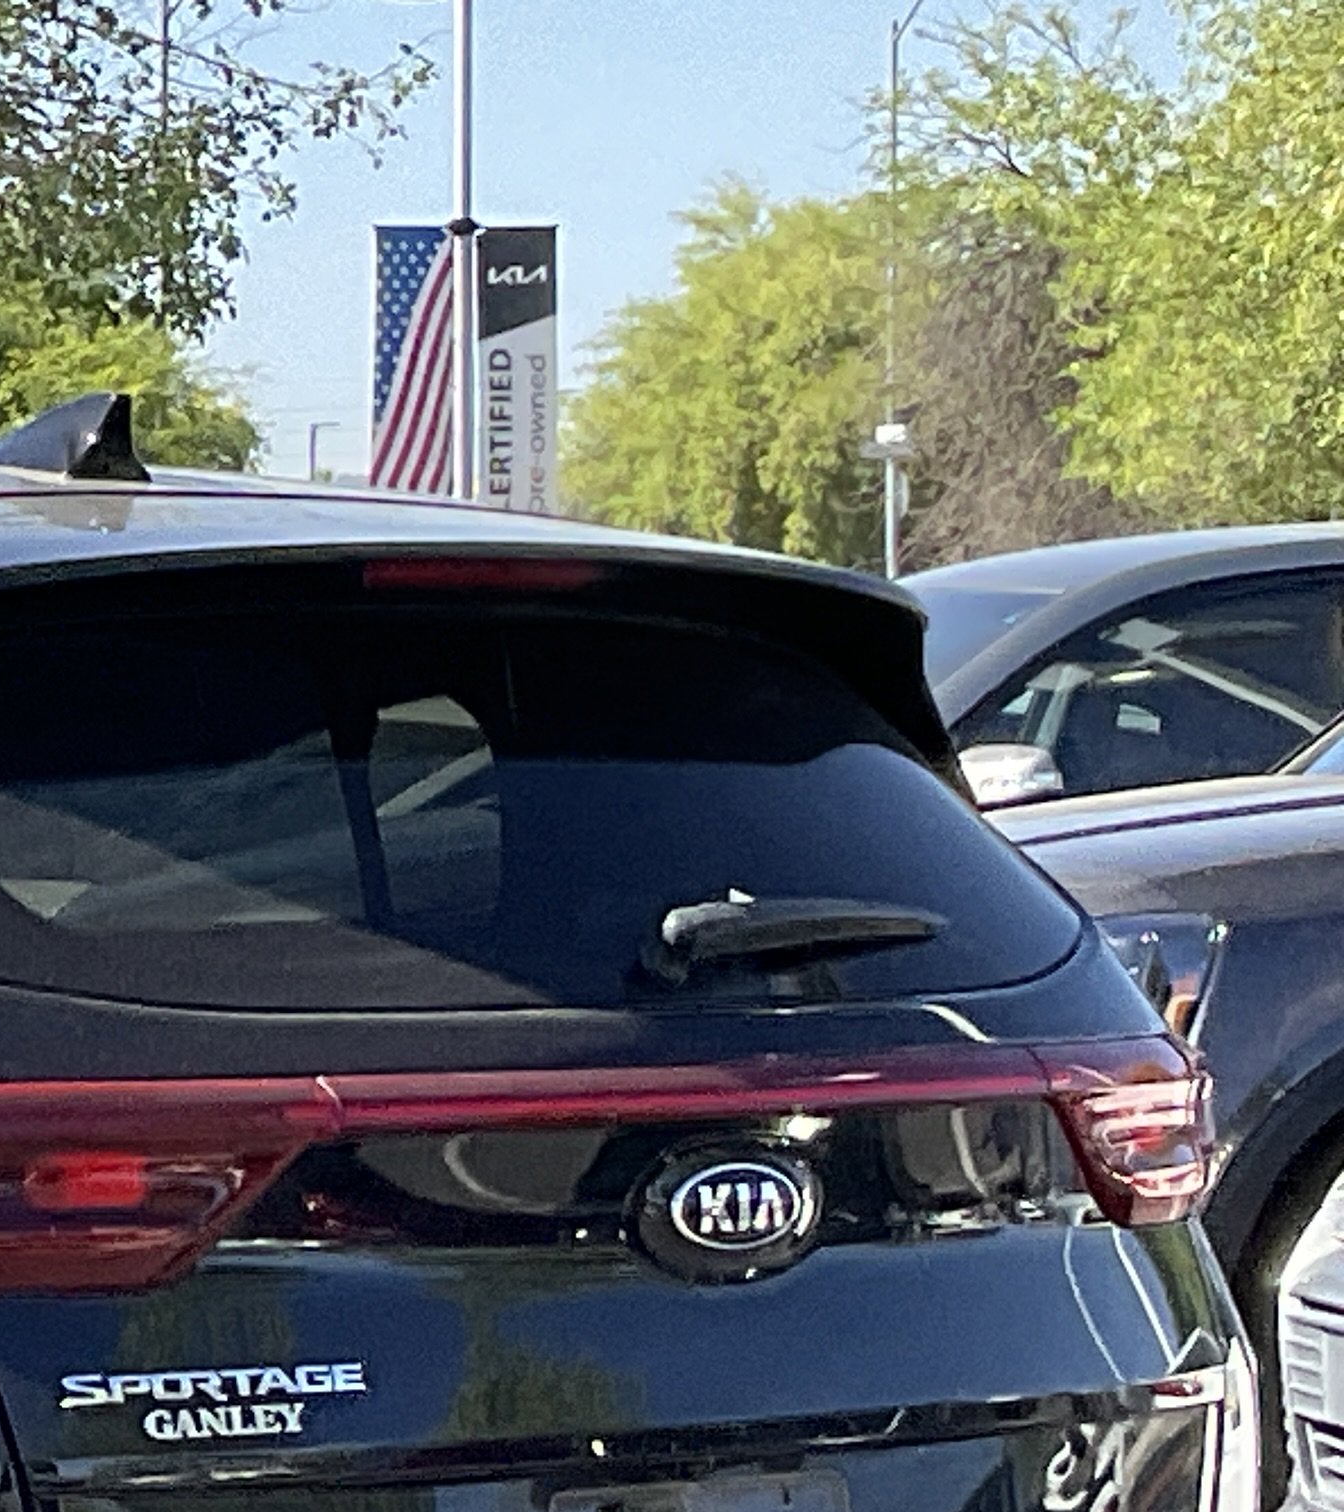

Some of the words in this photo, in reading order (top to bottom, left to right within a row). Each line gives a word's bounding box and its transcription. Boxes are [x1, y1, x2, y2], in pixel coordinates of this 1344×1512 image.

[487, 264, 548, 286] KIA
[698, 1181, 785, 1234] KIA
[59, 1362, 366, 1408] SPORTAGE
[143, 1402, 305, 1440] GANLEY
